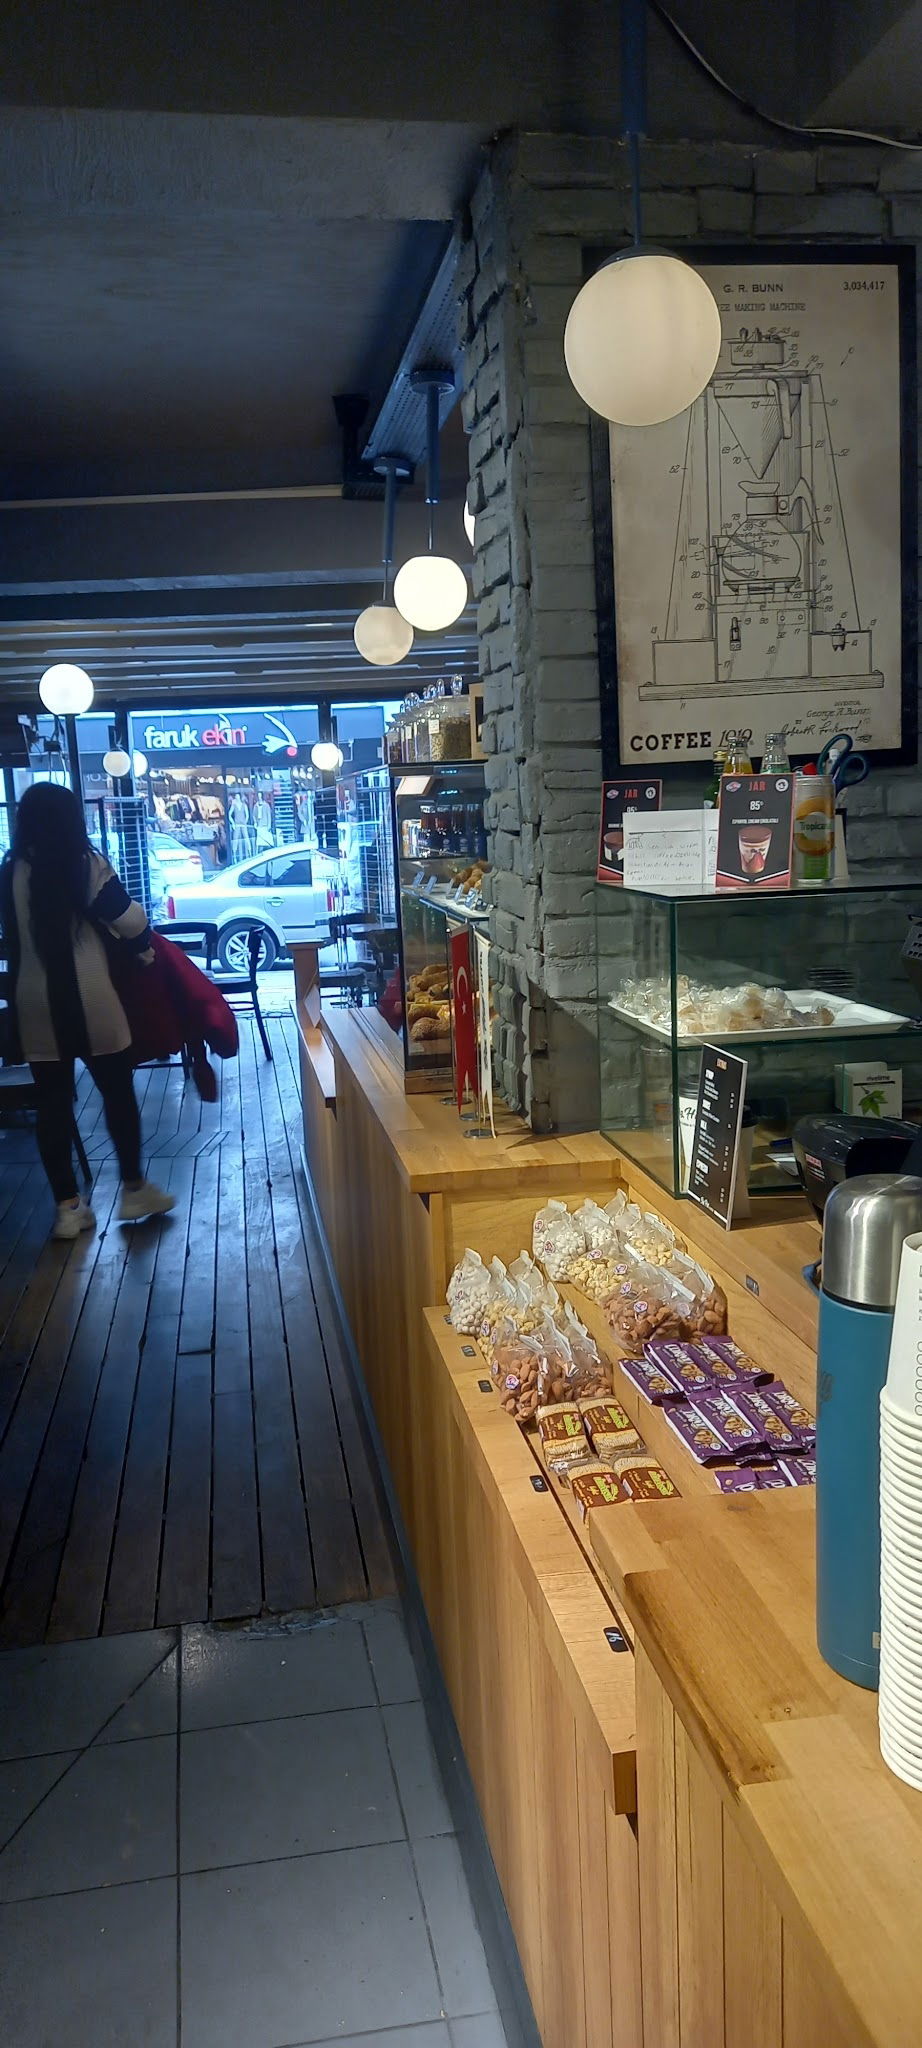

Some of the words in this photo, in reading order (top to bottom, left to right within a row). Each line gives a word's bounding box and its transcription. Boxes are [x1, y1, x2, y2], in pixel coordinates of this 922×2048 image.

[723, 284, 734, 293] G.
[738, 284, 748, 293] R.
[752, 284, 784, 293] BUNN
[843, 281, 885, 291] 3,034,417
[735, 303, 765, 311] MAKING
[770, 303, 806, 311] MACHINE
[144, 723, 200, 749] faruk
[202, 723, 246, 746] ekin
[630, 731, 712, 752] COFFEE
